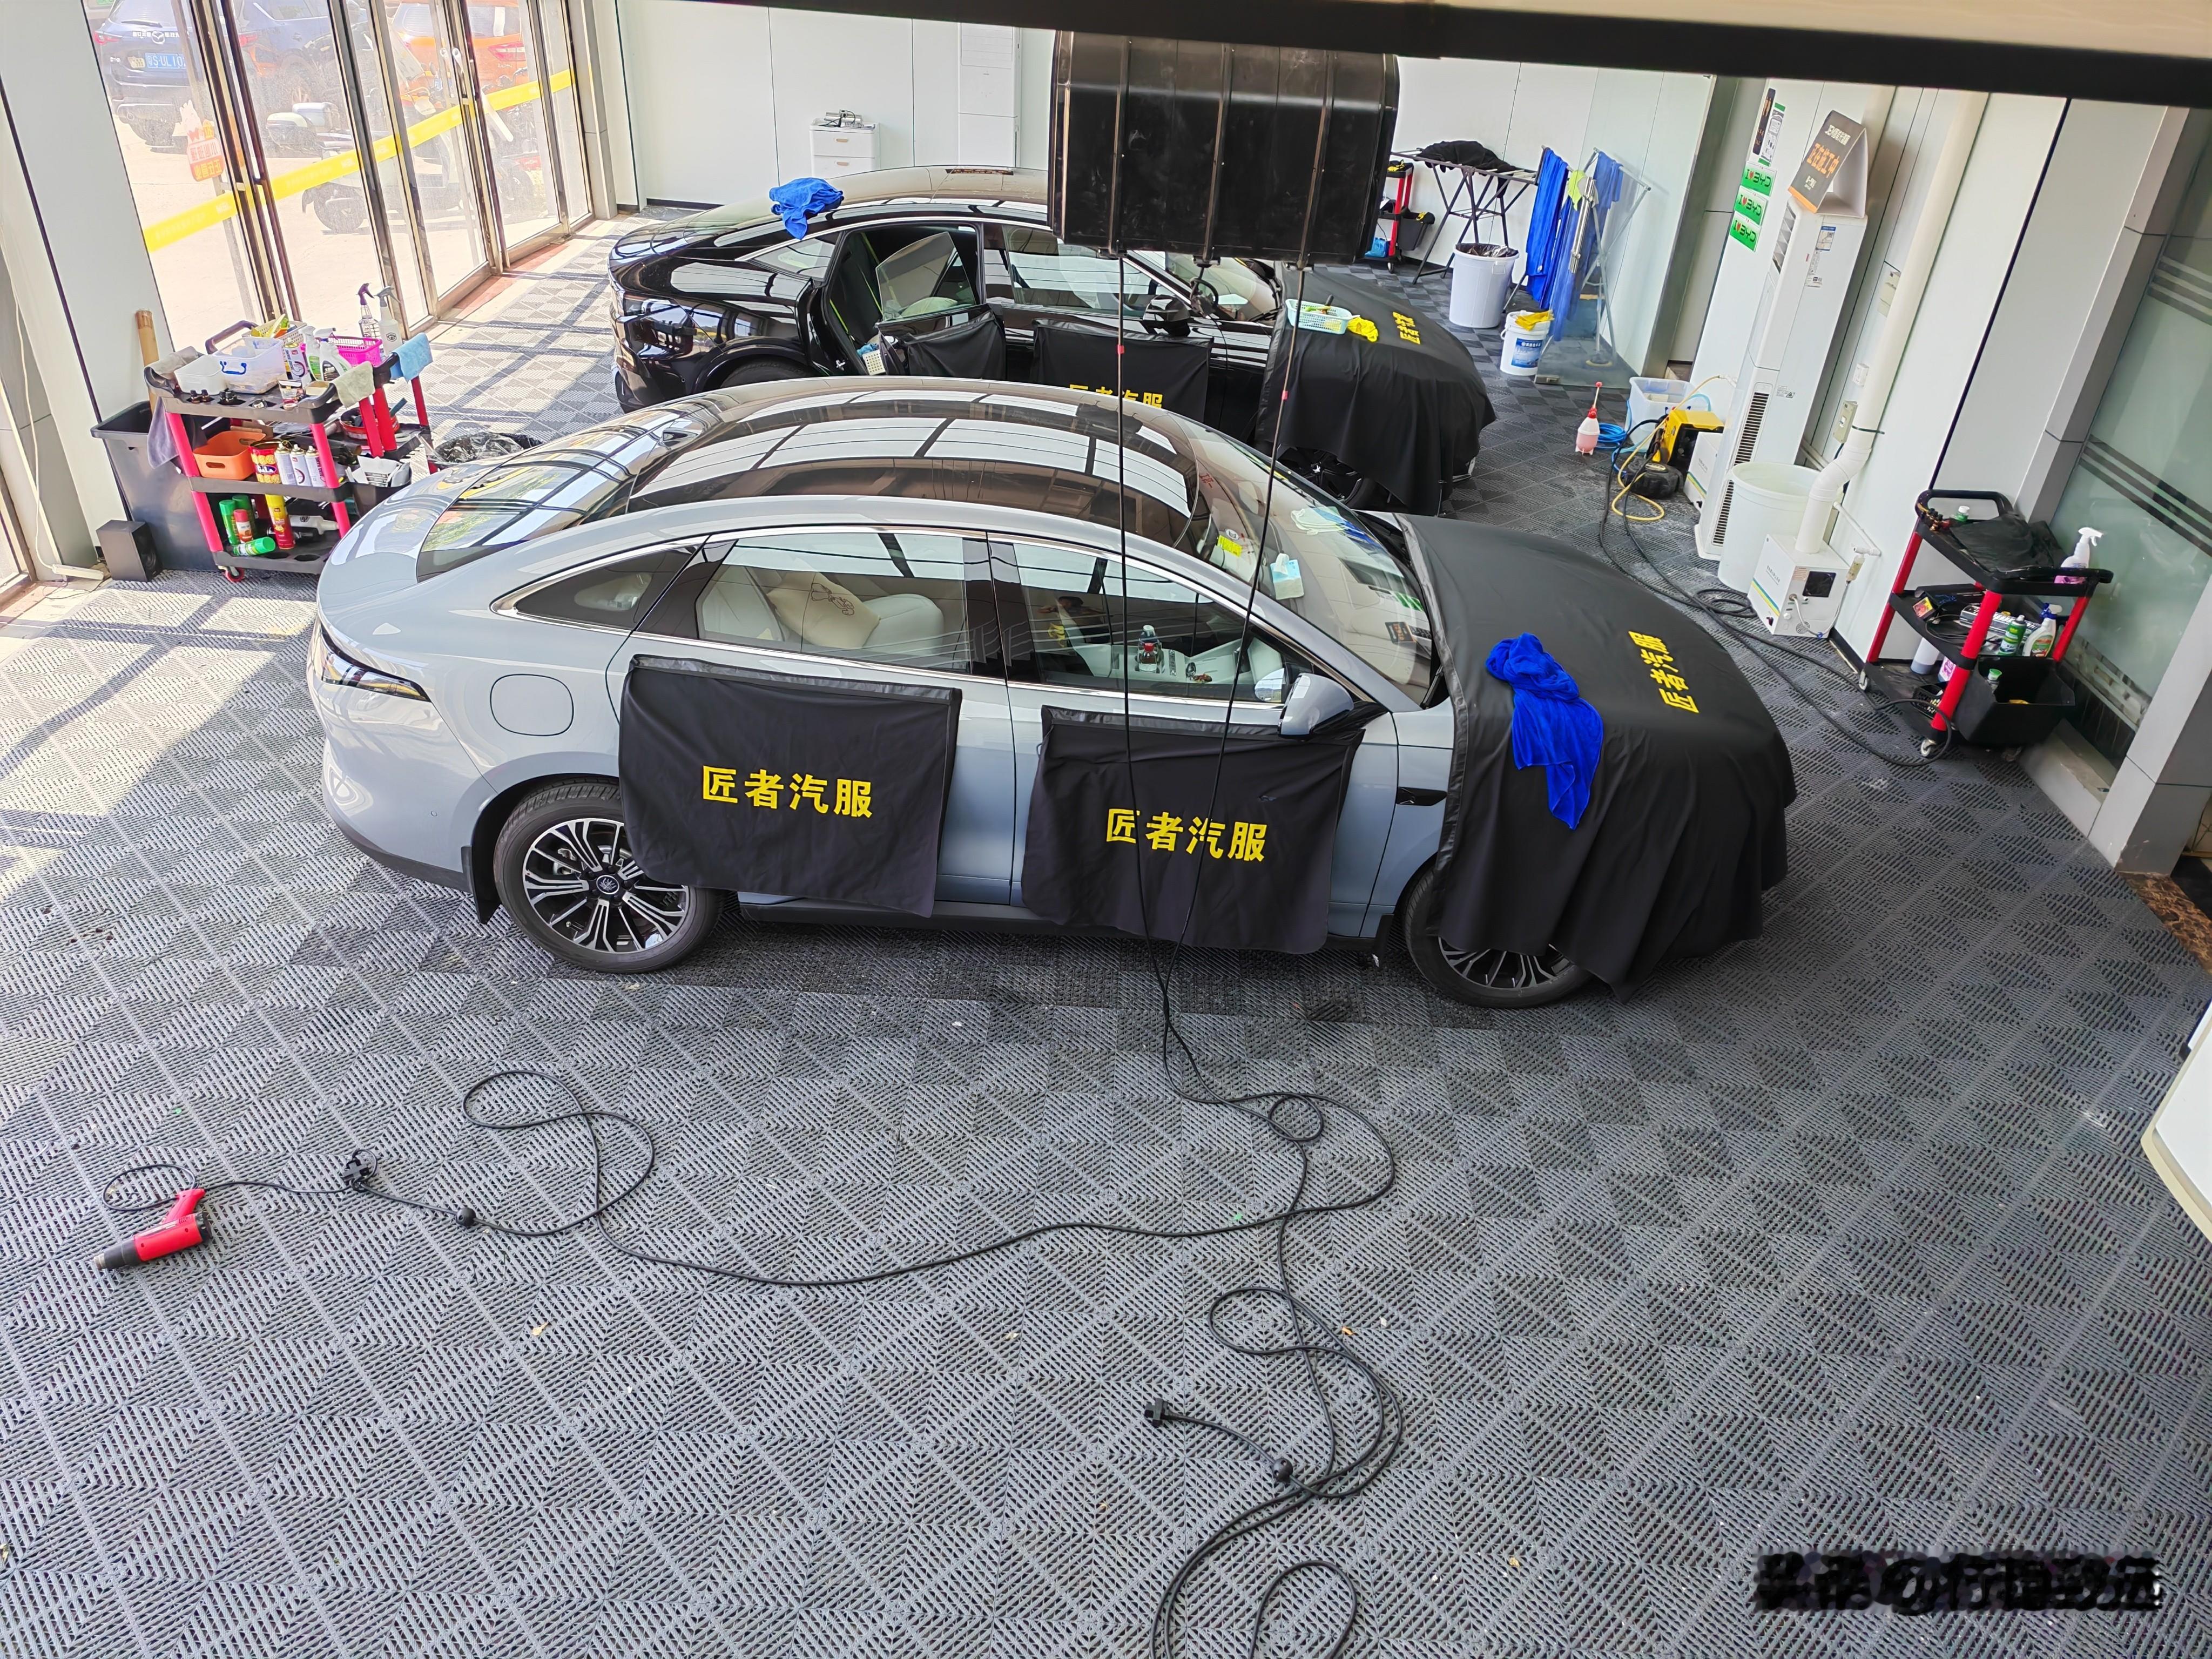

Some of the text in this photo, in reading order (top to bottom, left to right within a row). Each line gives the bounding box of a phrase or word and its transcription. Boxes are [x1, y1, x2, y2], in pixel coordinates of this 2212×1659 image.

[1628, 631, 1699, 713] 匠者汽服
[703, 765, 873, 818] 匠者汽服
[1106, 808, 1267, 862] 匠者汽服
